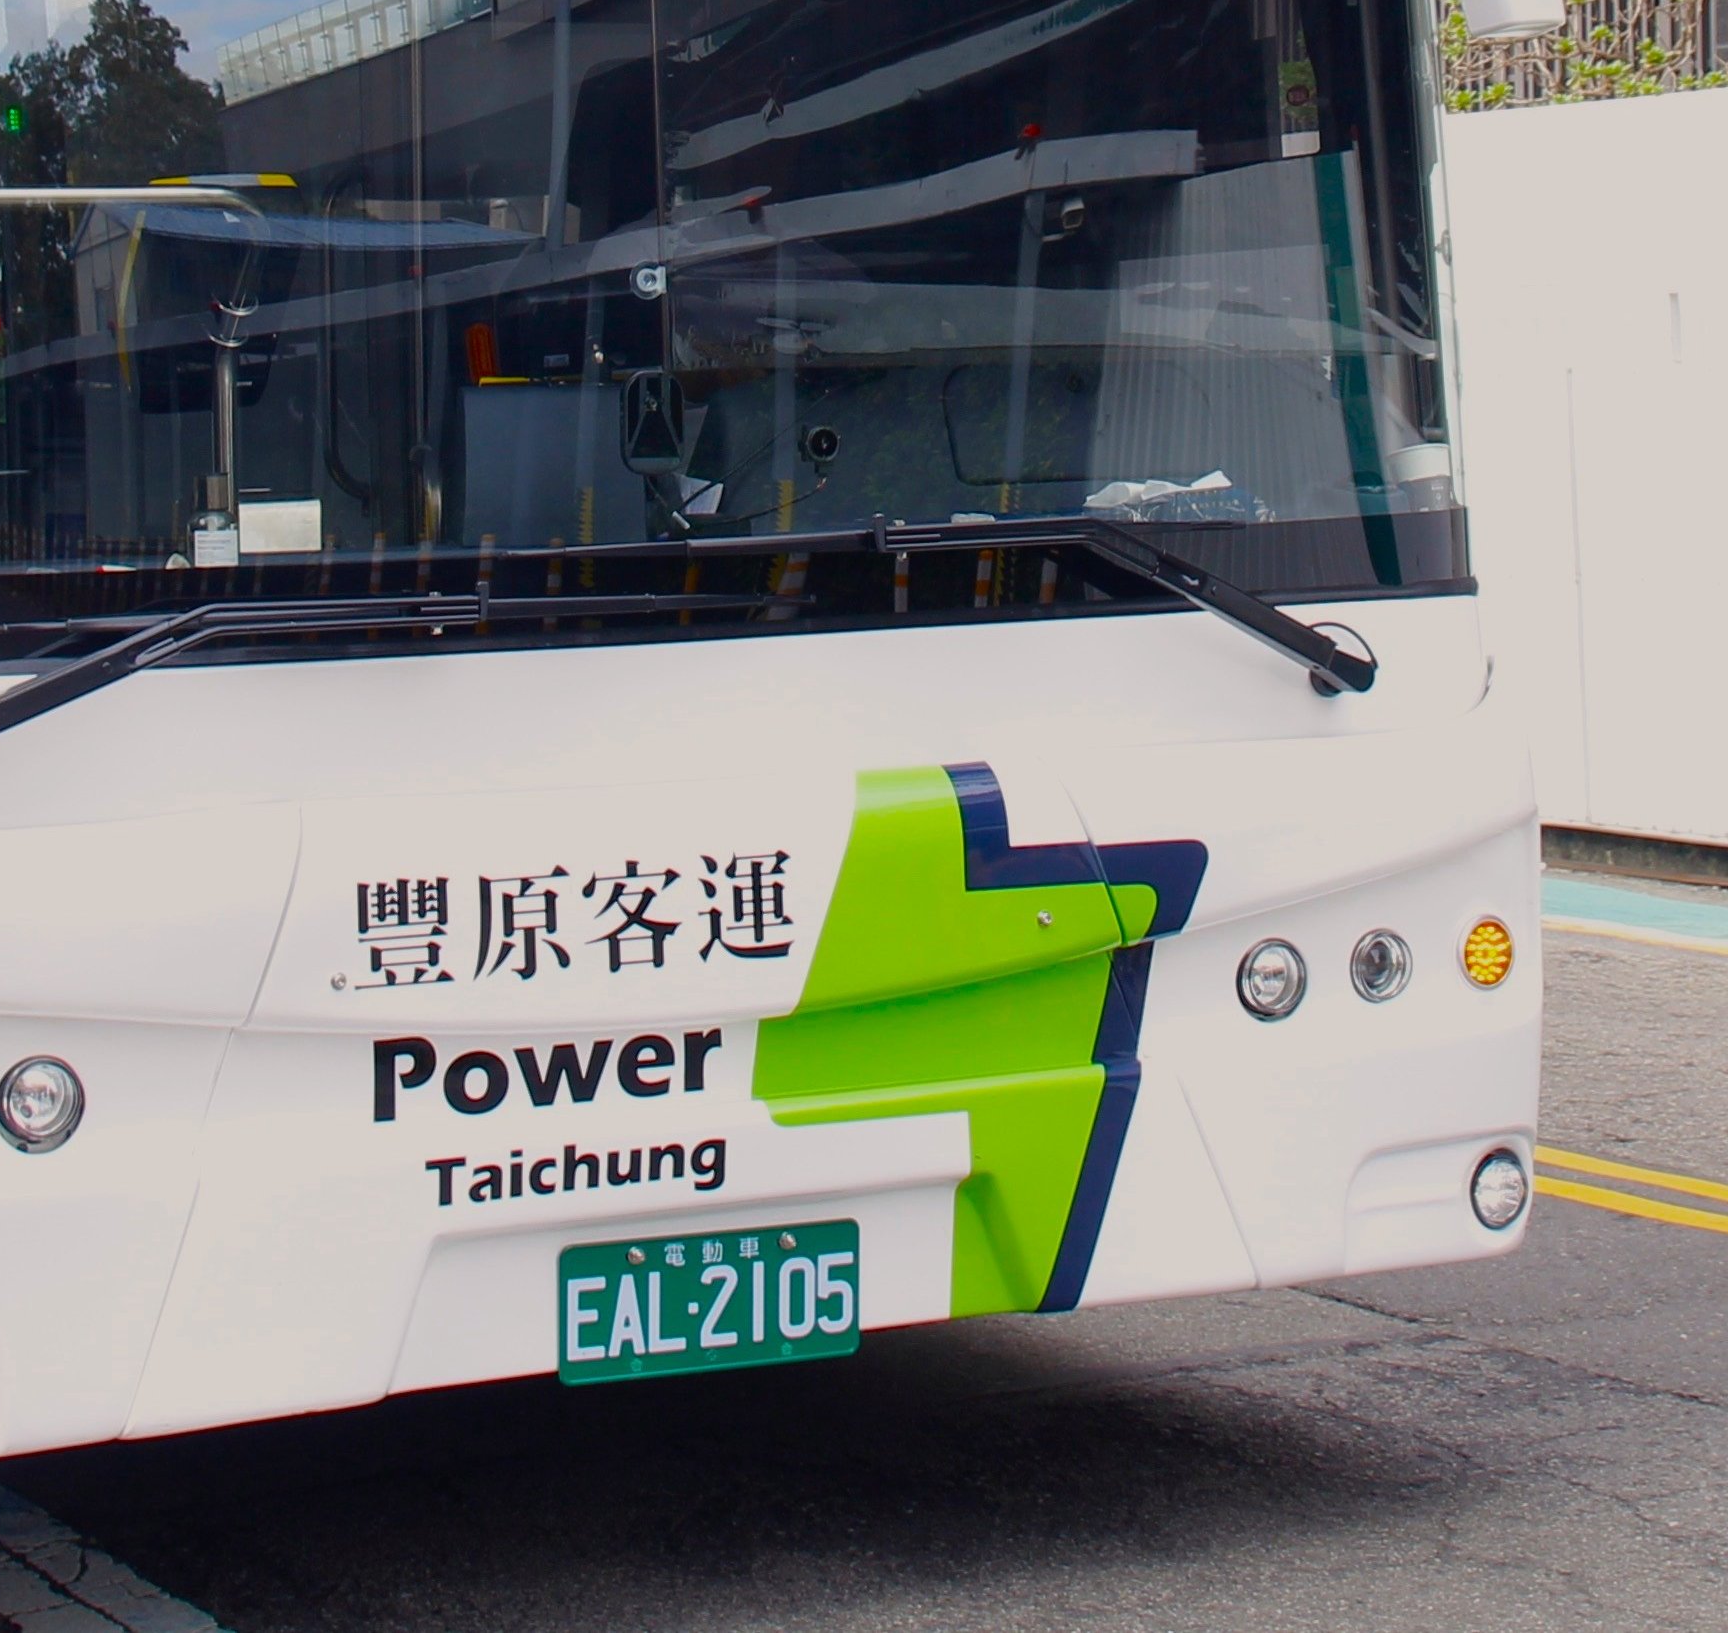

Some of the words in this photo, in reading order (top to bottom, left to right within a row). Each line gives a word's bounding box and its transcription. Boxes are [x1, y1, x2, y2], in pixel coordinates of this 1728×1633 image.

[354, 850, 796, 991] 豐原客運
[372, 1025, 724, 1123] Power
[424, 1137, 728, 1208] Taichung
[664, 1236, 760, 1267] 電動車
